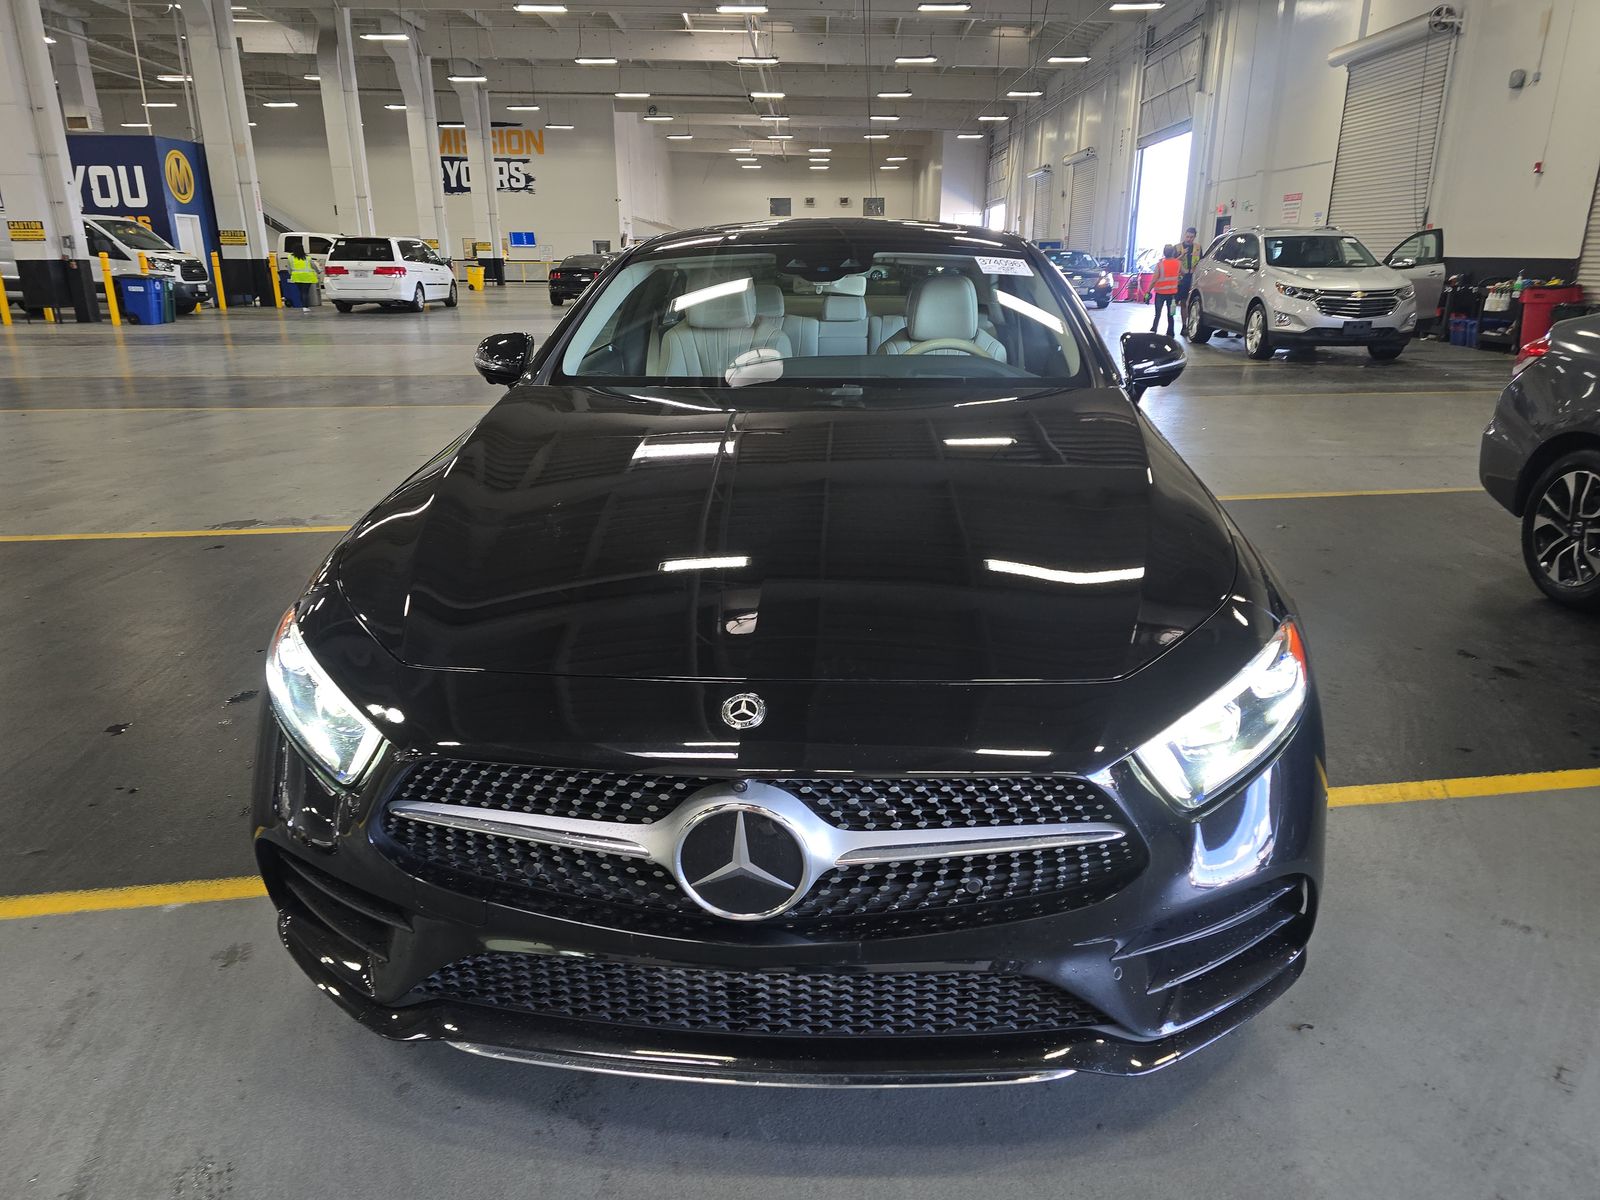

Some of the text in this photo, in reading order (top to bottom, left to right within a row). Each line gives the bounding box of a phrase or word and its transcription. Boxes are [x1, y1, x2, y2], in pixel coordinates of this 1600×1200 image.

[440, 128, 545, 155] MIION
[444, 160, 526, 189] YORS
[8, 221, 43, 230] CAUTION
